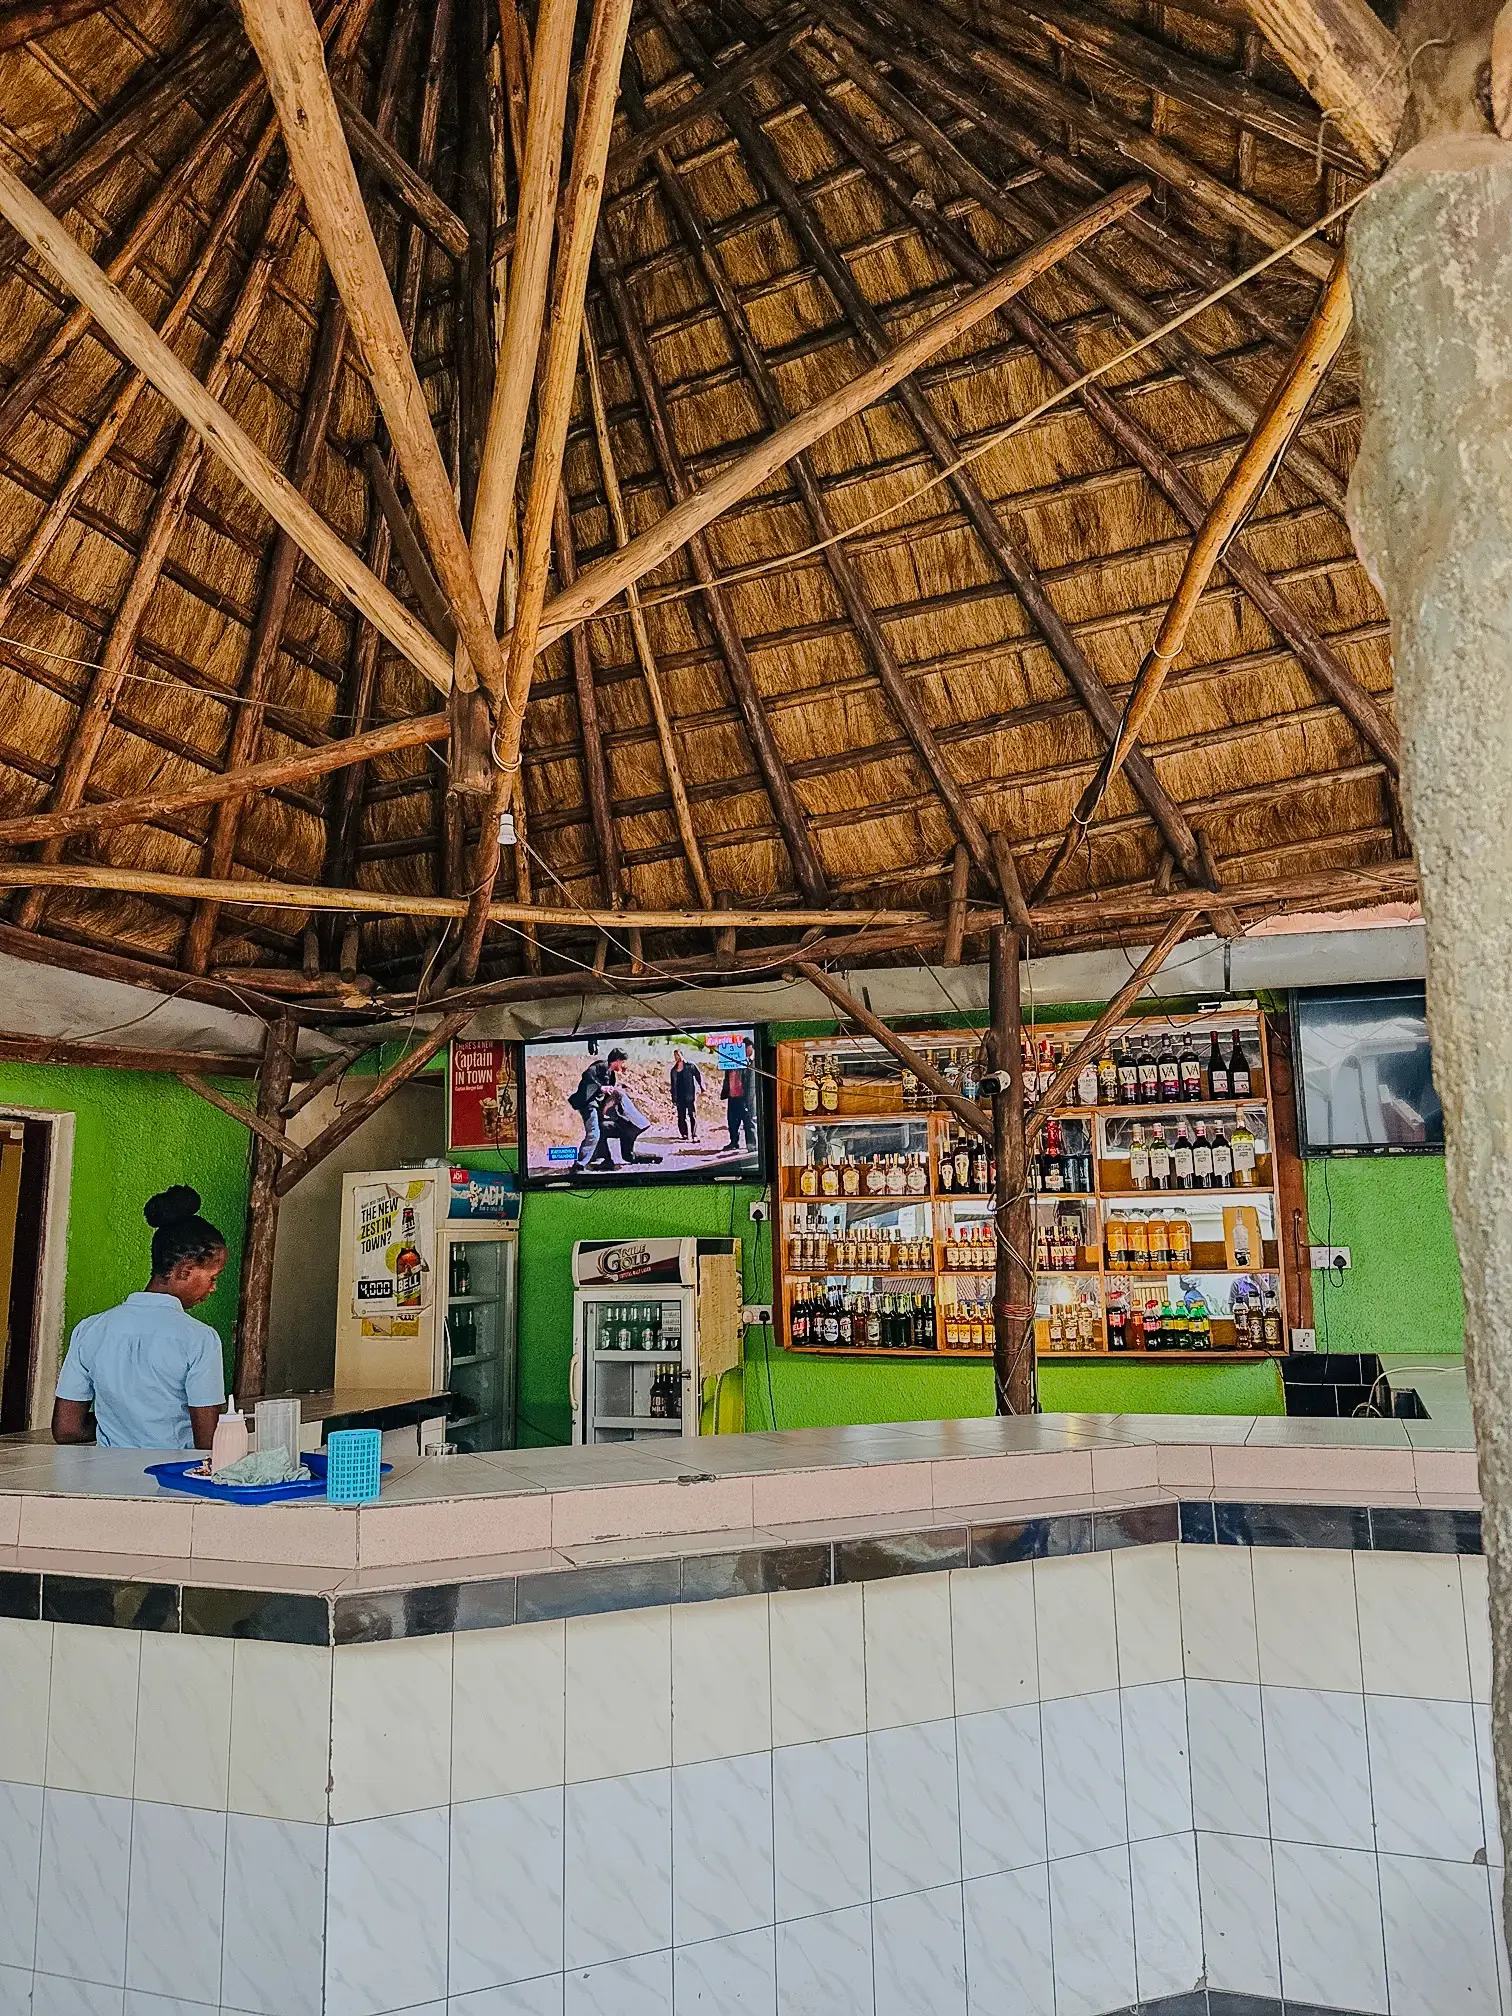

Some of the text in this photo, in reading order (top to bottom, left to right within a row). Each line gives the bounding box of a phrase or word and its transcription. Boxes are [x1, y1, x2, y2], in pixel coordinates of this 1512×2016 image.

[455, 1049, 493, 1071] Captain
[455, 1069, 493, 1085] IN TOWN
[361, 1197, 399, 1223] THE NEW
[361, 1219, 381, 1240] ZEST
[382, 1215, 392, 1231] IN
[361, 1231, 392, 1255] TOWN?
[621, 1244, 646, 1257] NILE
[602, 1248, 651, 1274] GOLD
[360, 1282, 390, 1297] 4,000
[398, 1274, 420, 1292] BELL
